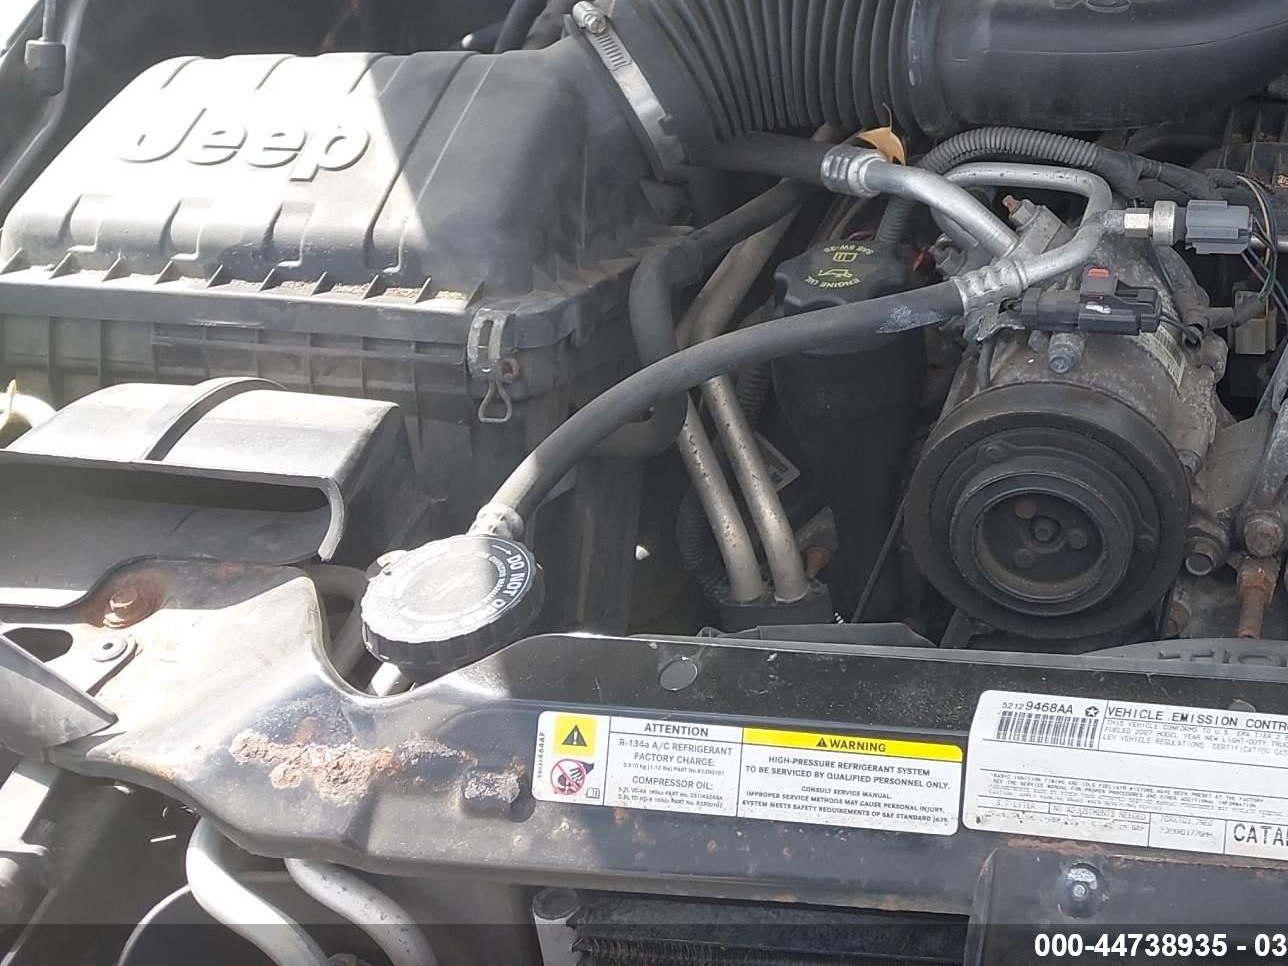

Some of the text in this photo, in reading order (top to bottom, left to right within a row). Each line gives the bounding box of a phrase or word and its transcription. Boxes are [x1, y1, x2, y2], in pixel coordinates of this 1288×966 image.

[117, 106, 371, 183] Jeep
[820, 278, 860, 289] ENGINE
[506, 554, 525, 570] DO
[502, 573, 525, 596] NOT
[1107, 706, 1164, 721] VEHICLE
[1171, 712, 1238, 727] EMISSION
[644, 722, 709, 737] ATTENTION
[1163, 724, 1198, 733] CONFORMS
[619, 738, 732, 755] R-134a A/C REFRIGERANT
[829, 738, 886, 753] WARNING
[634, 752, 716, 767] FACTORY CHARGE:
[768, 755, 930, 776] HIGH-PRESSURE REFRIGERANT SYSTEM
[632, 776, 713, 790] COMPRESSOR OIL:
[746, 765, 951, 790] TO BE SERVICED BY QUALIFIED PERSONNEL ONLY.
[801, 786, 832, 794] CONSULT
[833, 788, 861, 797] SERVICE
[746, 791, 780, 799] IMPROPER
[782, 793, 809, 801] SERVICE
[810, 795, 843, 805] METHODS
[860, 800, 881, 808] CAUSE
[883, 802, 918, 812] PERSONAL
[742, 800, 768, 808] SYSTEM
[770, 802, 791, 810] MEETS
[793, 803, 817, 812] SAFETY
[818, 805, 870, 816] REQUIREMENTS
[896, 812, 931, 822] STANDARD
